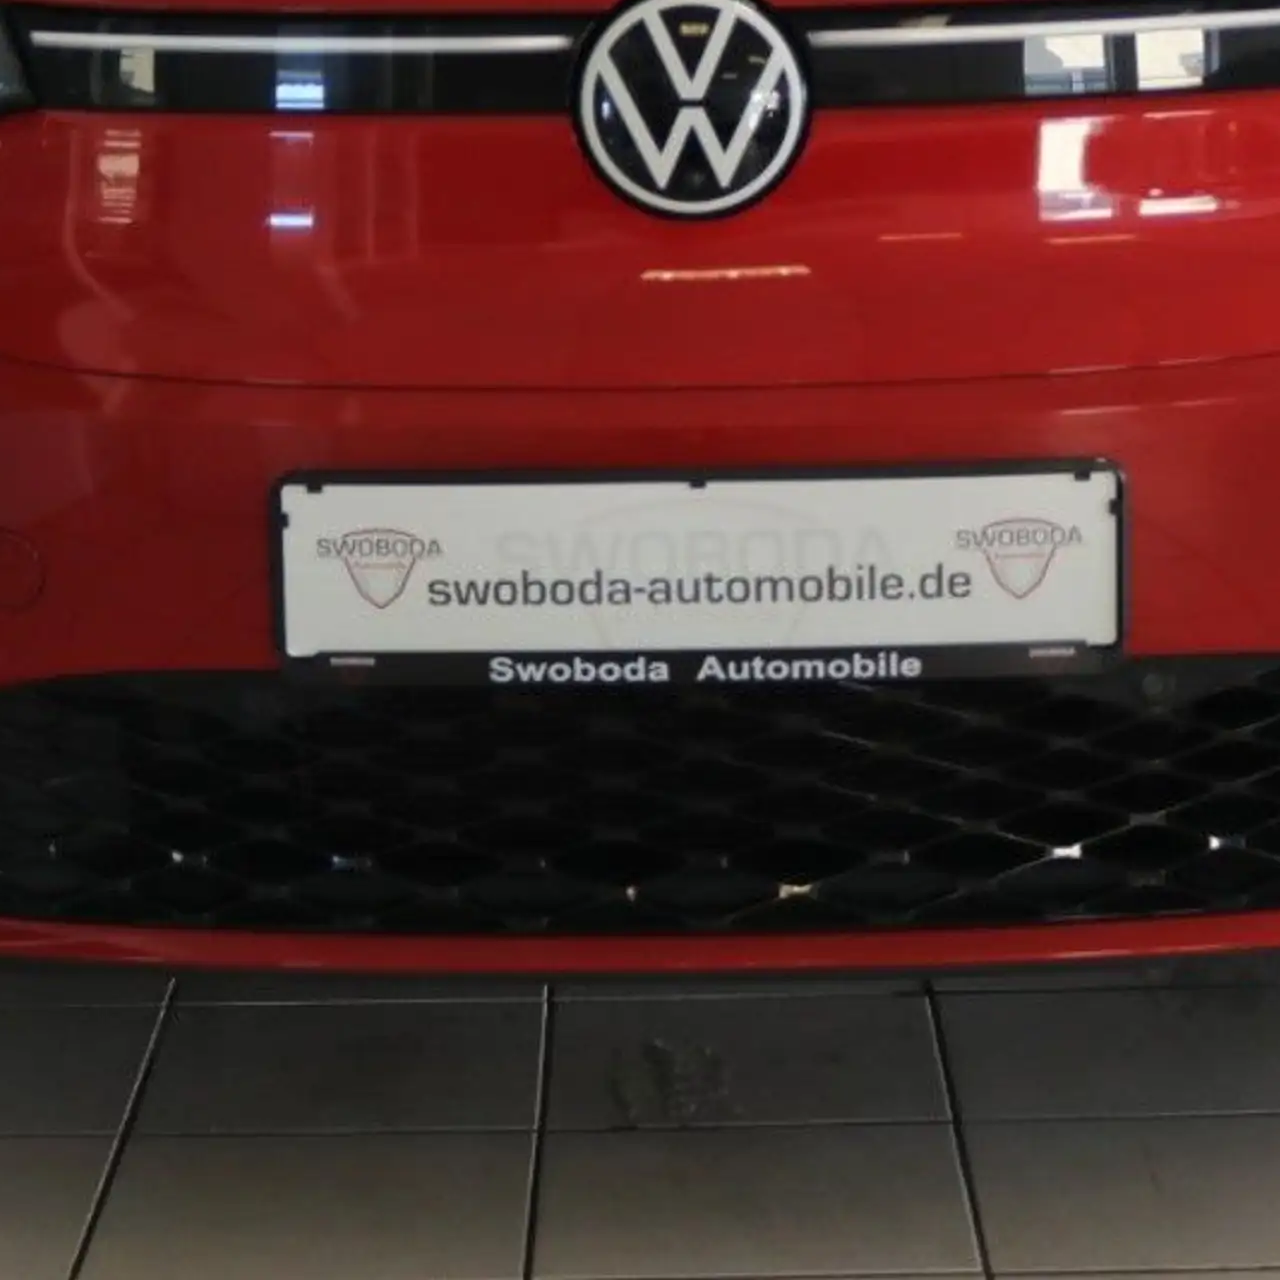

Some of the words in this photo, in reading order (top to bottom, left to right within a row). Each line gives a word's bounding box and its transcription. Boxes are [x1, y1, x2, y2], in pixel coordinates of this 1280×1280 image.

[316, 537, 444, 560] SWOBODA
[956, 526, 1083, 549] SWOBODA
[426, 563, 973, 608] swoboda-automobile.de
[488, 656, 671, 683] Swoboda
[697, 651, 924, 681] Automobile
